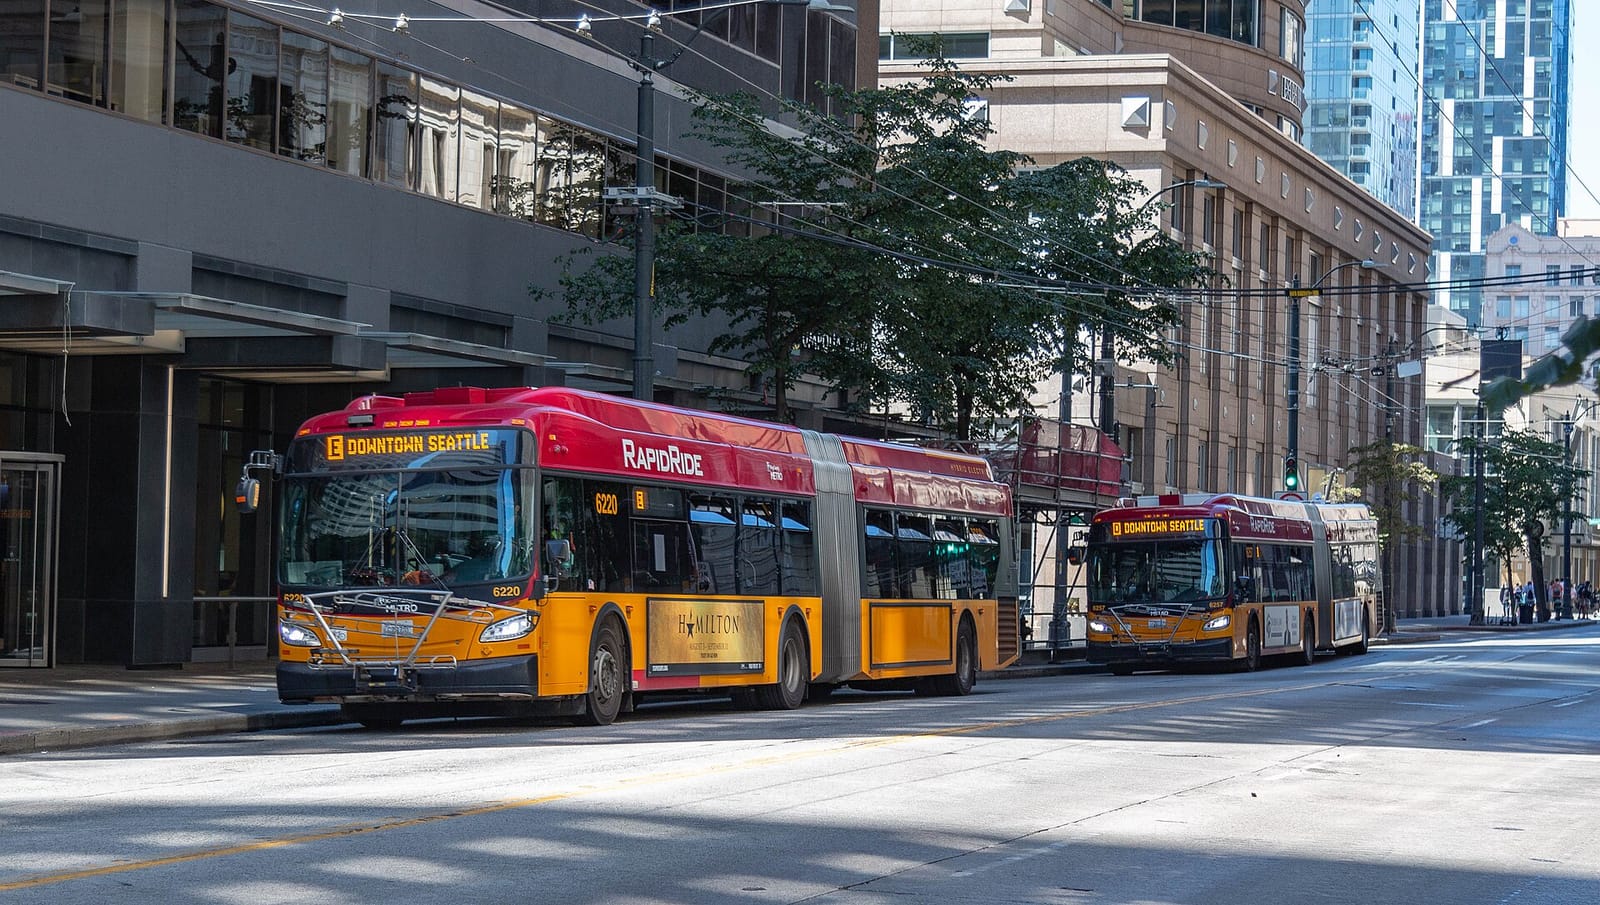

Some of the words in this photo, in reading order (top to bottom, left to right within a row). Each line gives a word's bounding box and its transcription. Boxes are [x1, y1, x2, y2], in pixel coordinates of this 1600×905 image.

[327, 435, 345, 461] E
[347, 435, 424, 455] DOWNTOWN
[428, 433, 489, 451] SEATTLE
[595, 492, 618, 516] 6220
[1124, 521, 1168, 534] DOWNTOWN
[1169, 519, 1205, 532] SEATTLE
[492, 586, 521, 598] 6220
